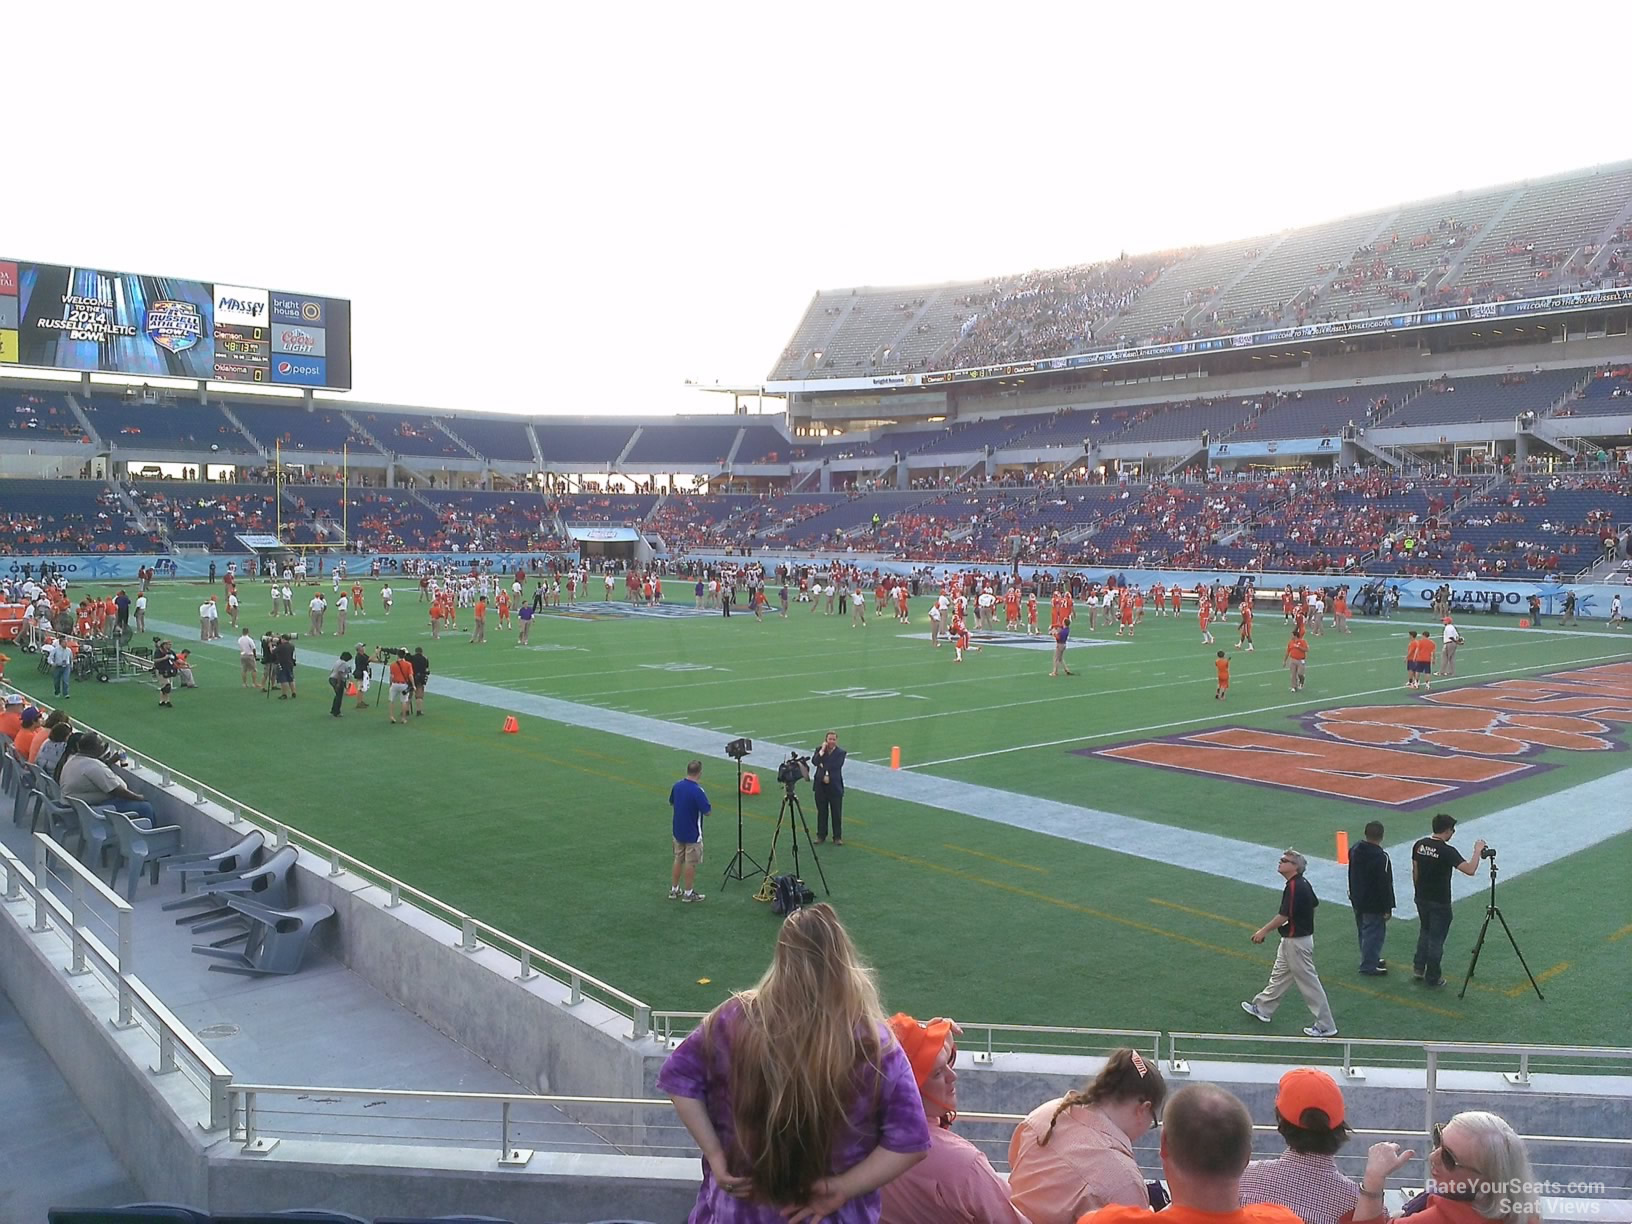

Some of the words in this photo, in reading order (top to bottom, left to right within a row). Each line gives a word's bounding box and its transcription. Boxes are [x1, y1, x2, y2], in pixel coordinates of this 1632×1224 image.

[62, 295, 113, 308] WELCOME
[273, 299, 300, 309] bright
[86, 305, 101, 313] THE
[273, 306, 300, 317] house
[69, 310, 106, 324] 2014
[150, 314, 198, 325] RUSSELL
[37, 318, 83, 331] RUSSELL
[82, 321, 136, 336] ATHLETIC
[150, 320, 199, 331] ATHLETIC
[70, 330, 106, 342] BOWL
[159, 328, 189, 336] BOWL
[213, 330, 243, 340] Clemson
[253, 328, 262, 340] 0
[281, 329, 315, 346] Coors
[224, 341, 250, 352] 48:13
[283, 343, 314, 353] LIGHT
[213, 363, 248, 374] Oklahoma
[292, 365, 320, 376] pepsi
[254, 369, 262, 381] 0
[1420, 588, 1521, 605] OLANDO
[10, 626, 19, 635] G
[742, 775, 754, 791] G
